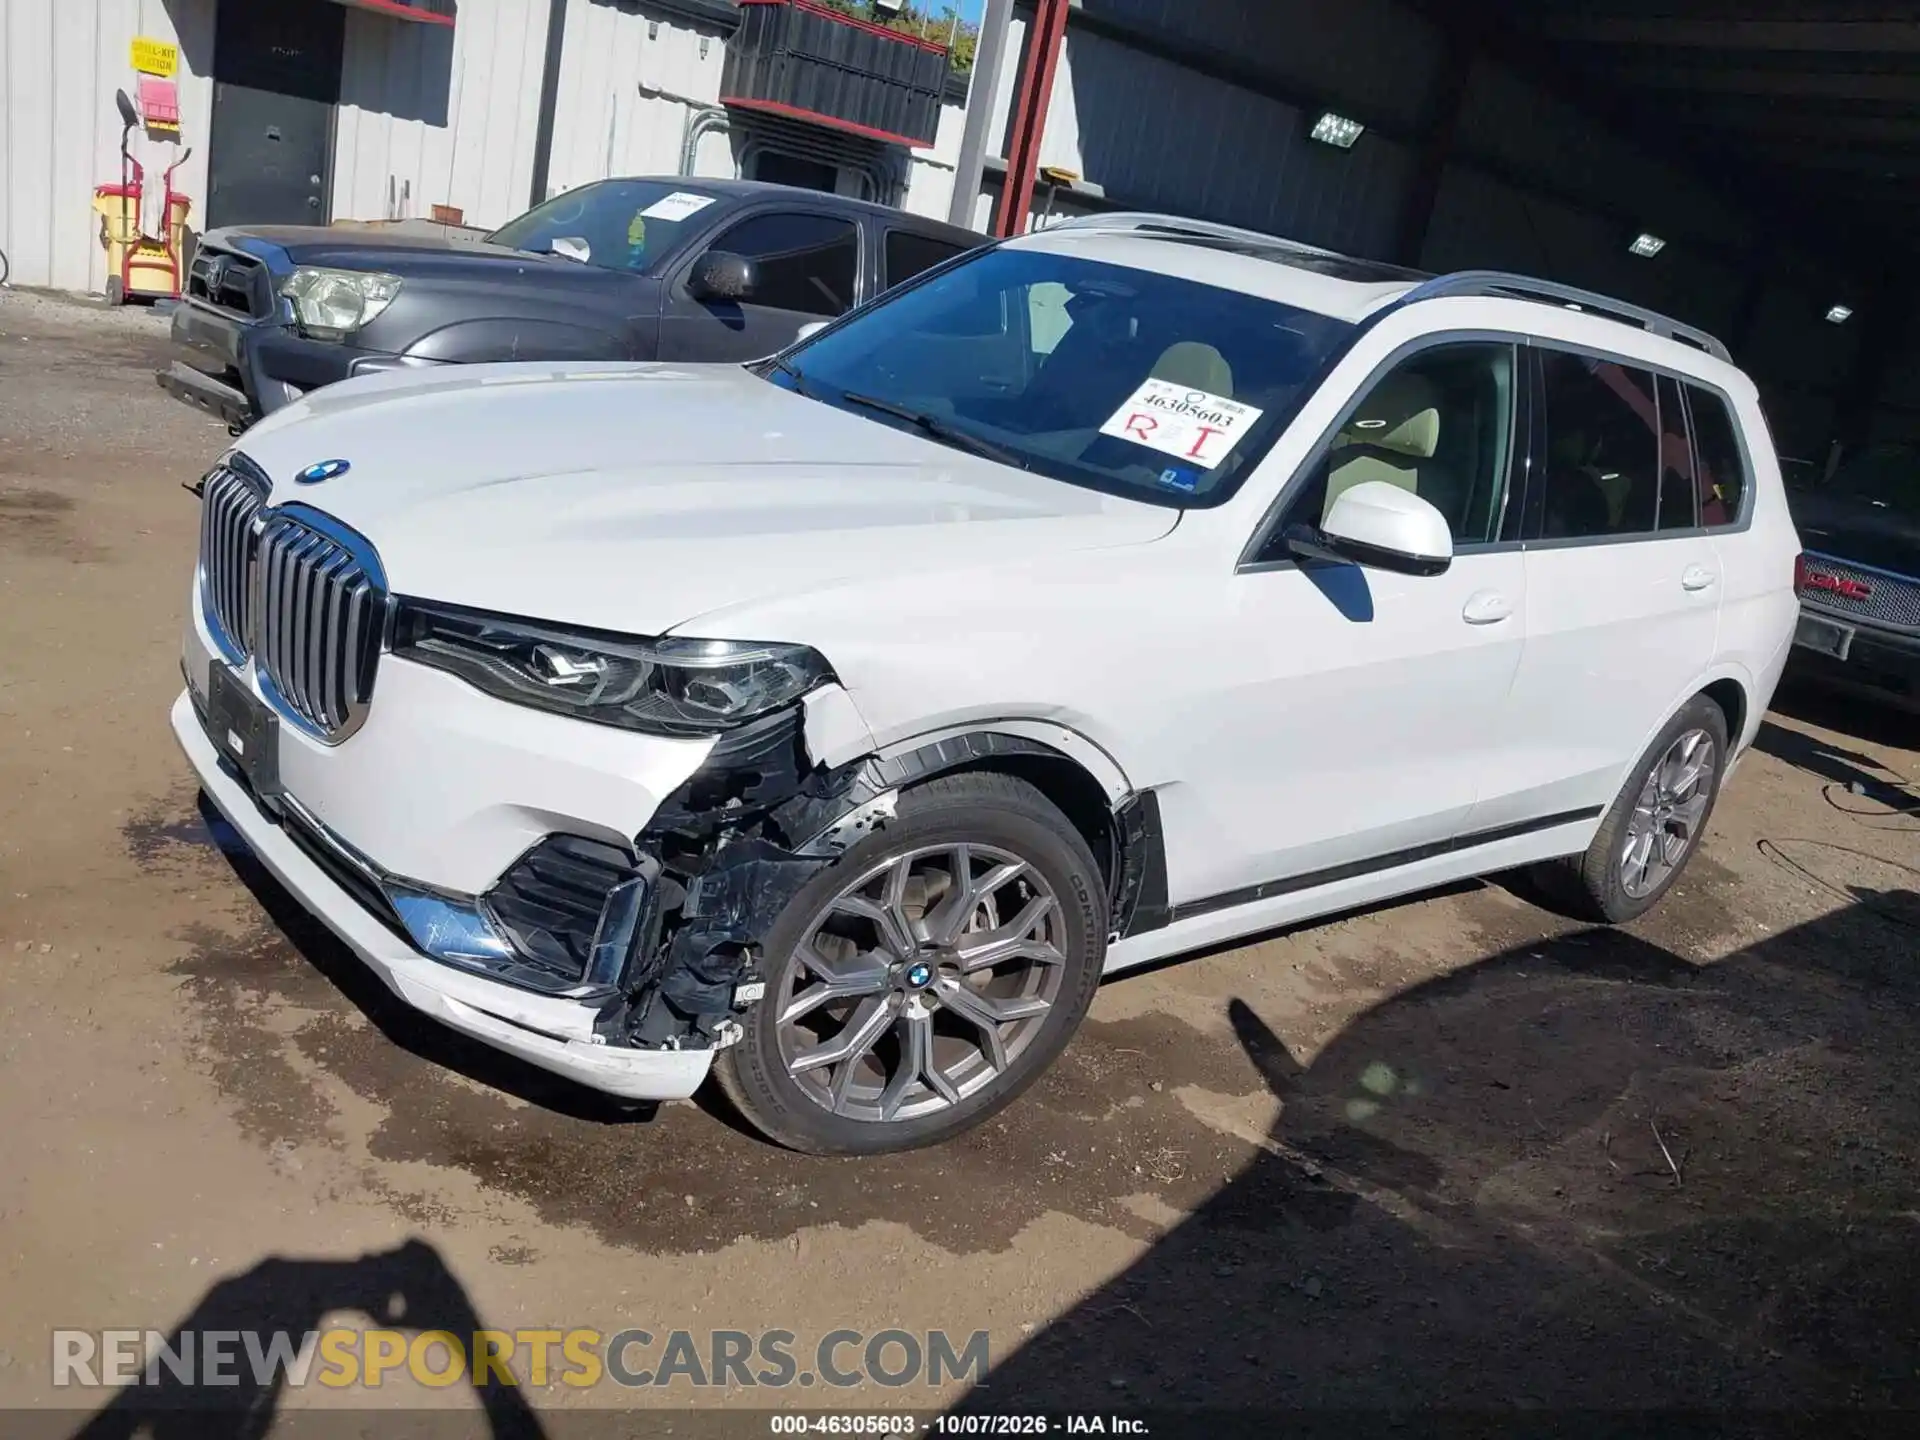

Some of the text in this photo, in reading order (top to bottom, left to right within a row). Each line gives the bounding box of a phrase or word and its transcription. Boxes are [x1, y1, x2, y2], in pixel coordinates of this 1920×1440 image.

[1144, 394, 1234, 427] 46305603
[1125, 413, 1158, 440] R
[1807, 571, 1875, 601] GMC
